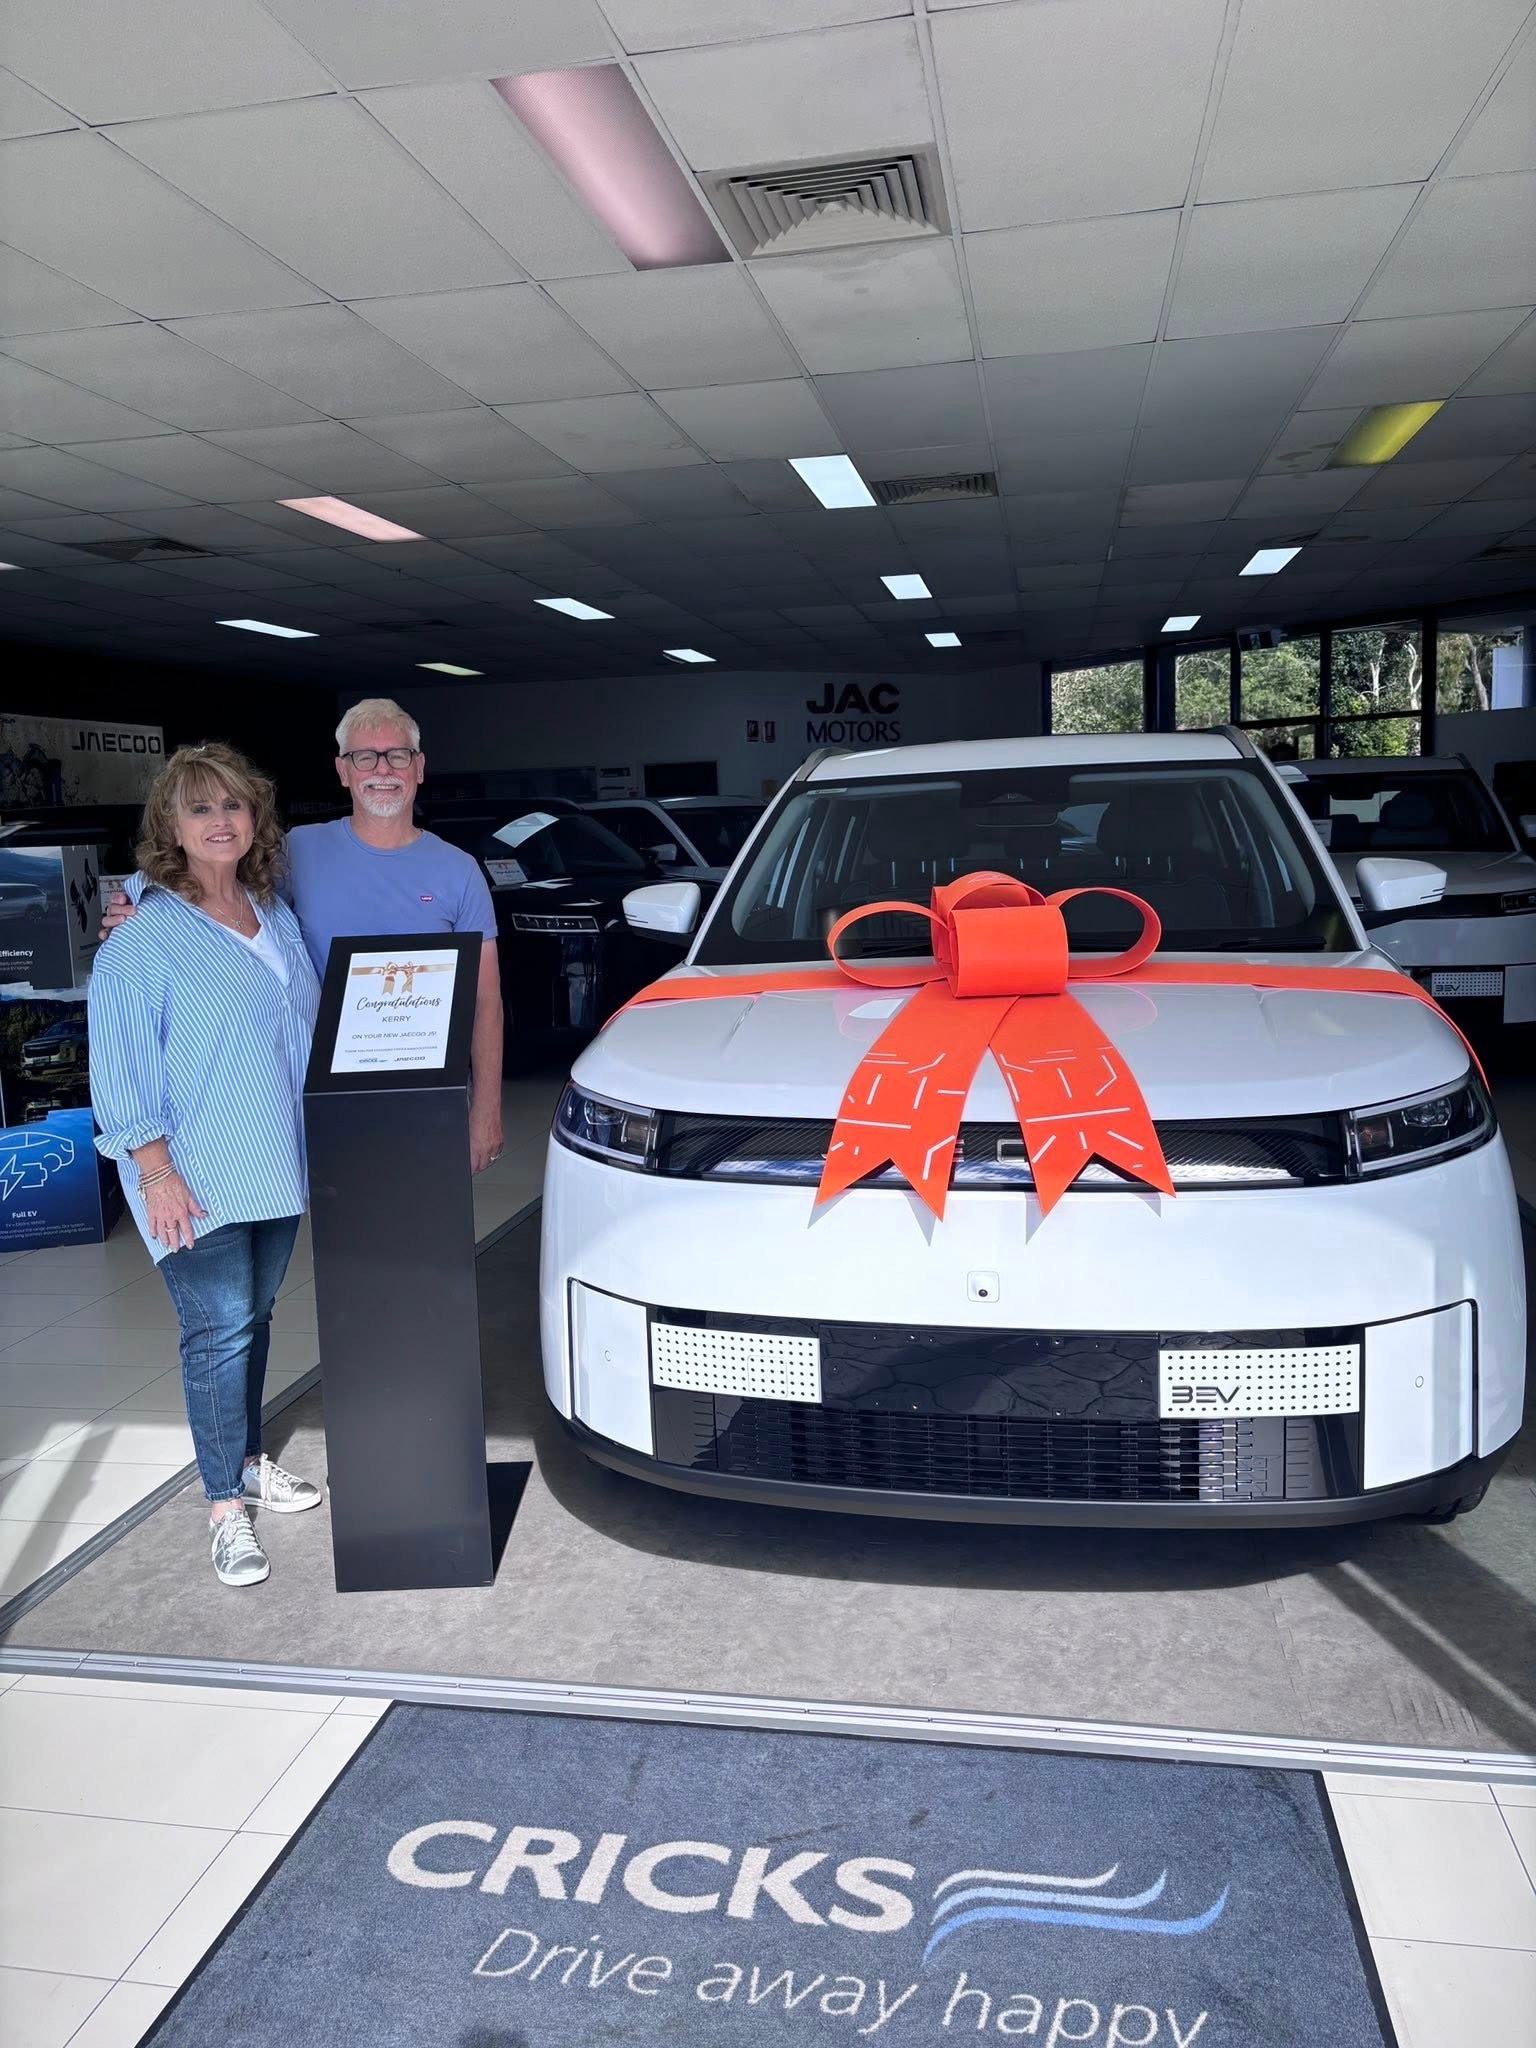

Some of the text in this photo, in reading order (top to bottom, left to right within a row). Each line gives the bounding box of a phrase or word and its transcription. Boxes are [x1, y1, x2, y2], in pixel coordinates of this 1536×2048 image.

[806, 682, 900, 714] JAC
[72, 731, 162, 754] JAECOO
[806, 720, 900, 744] MOTORS
[356, 995, 441, 1012] Congratulations
[363, 1032, 383, 1040] YOUR
[12, 1210, 27, 1219] Full
[1172, 1385, 1242, 1404] BEV
[386, 1819, 916, 1933] CRICKS
[472, 1927, 1208, 2048] Drive away happy
